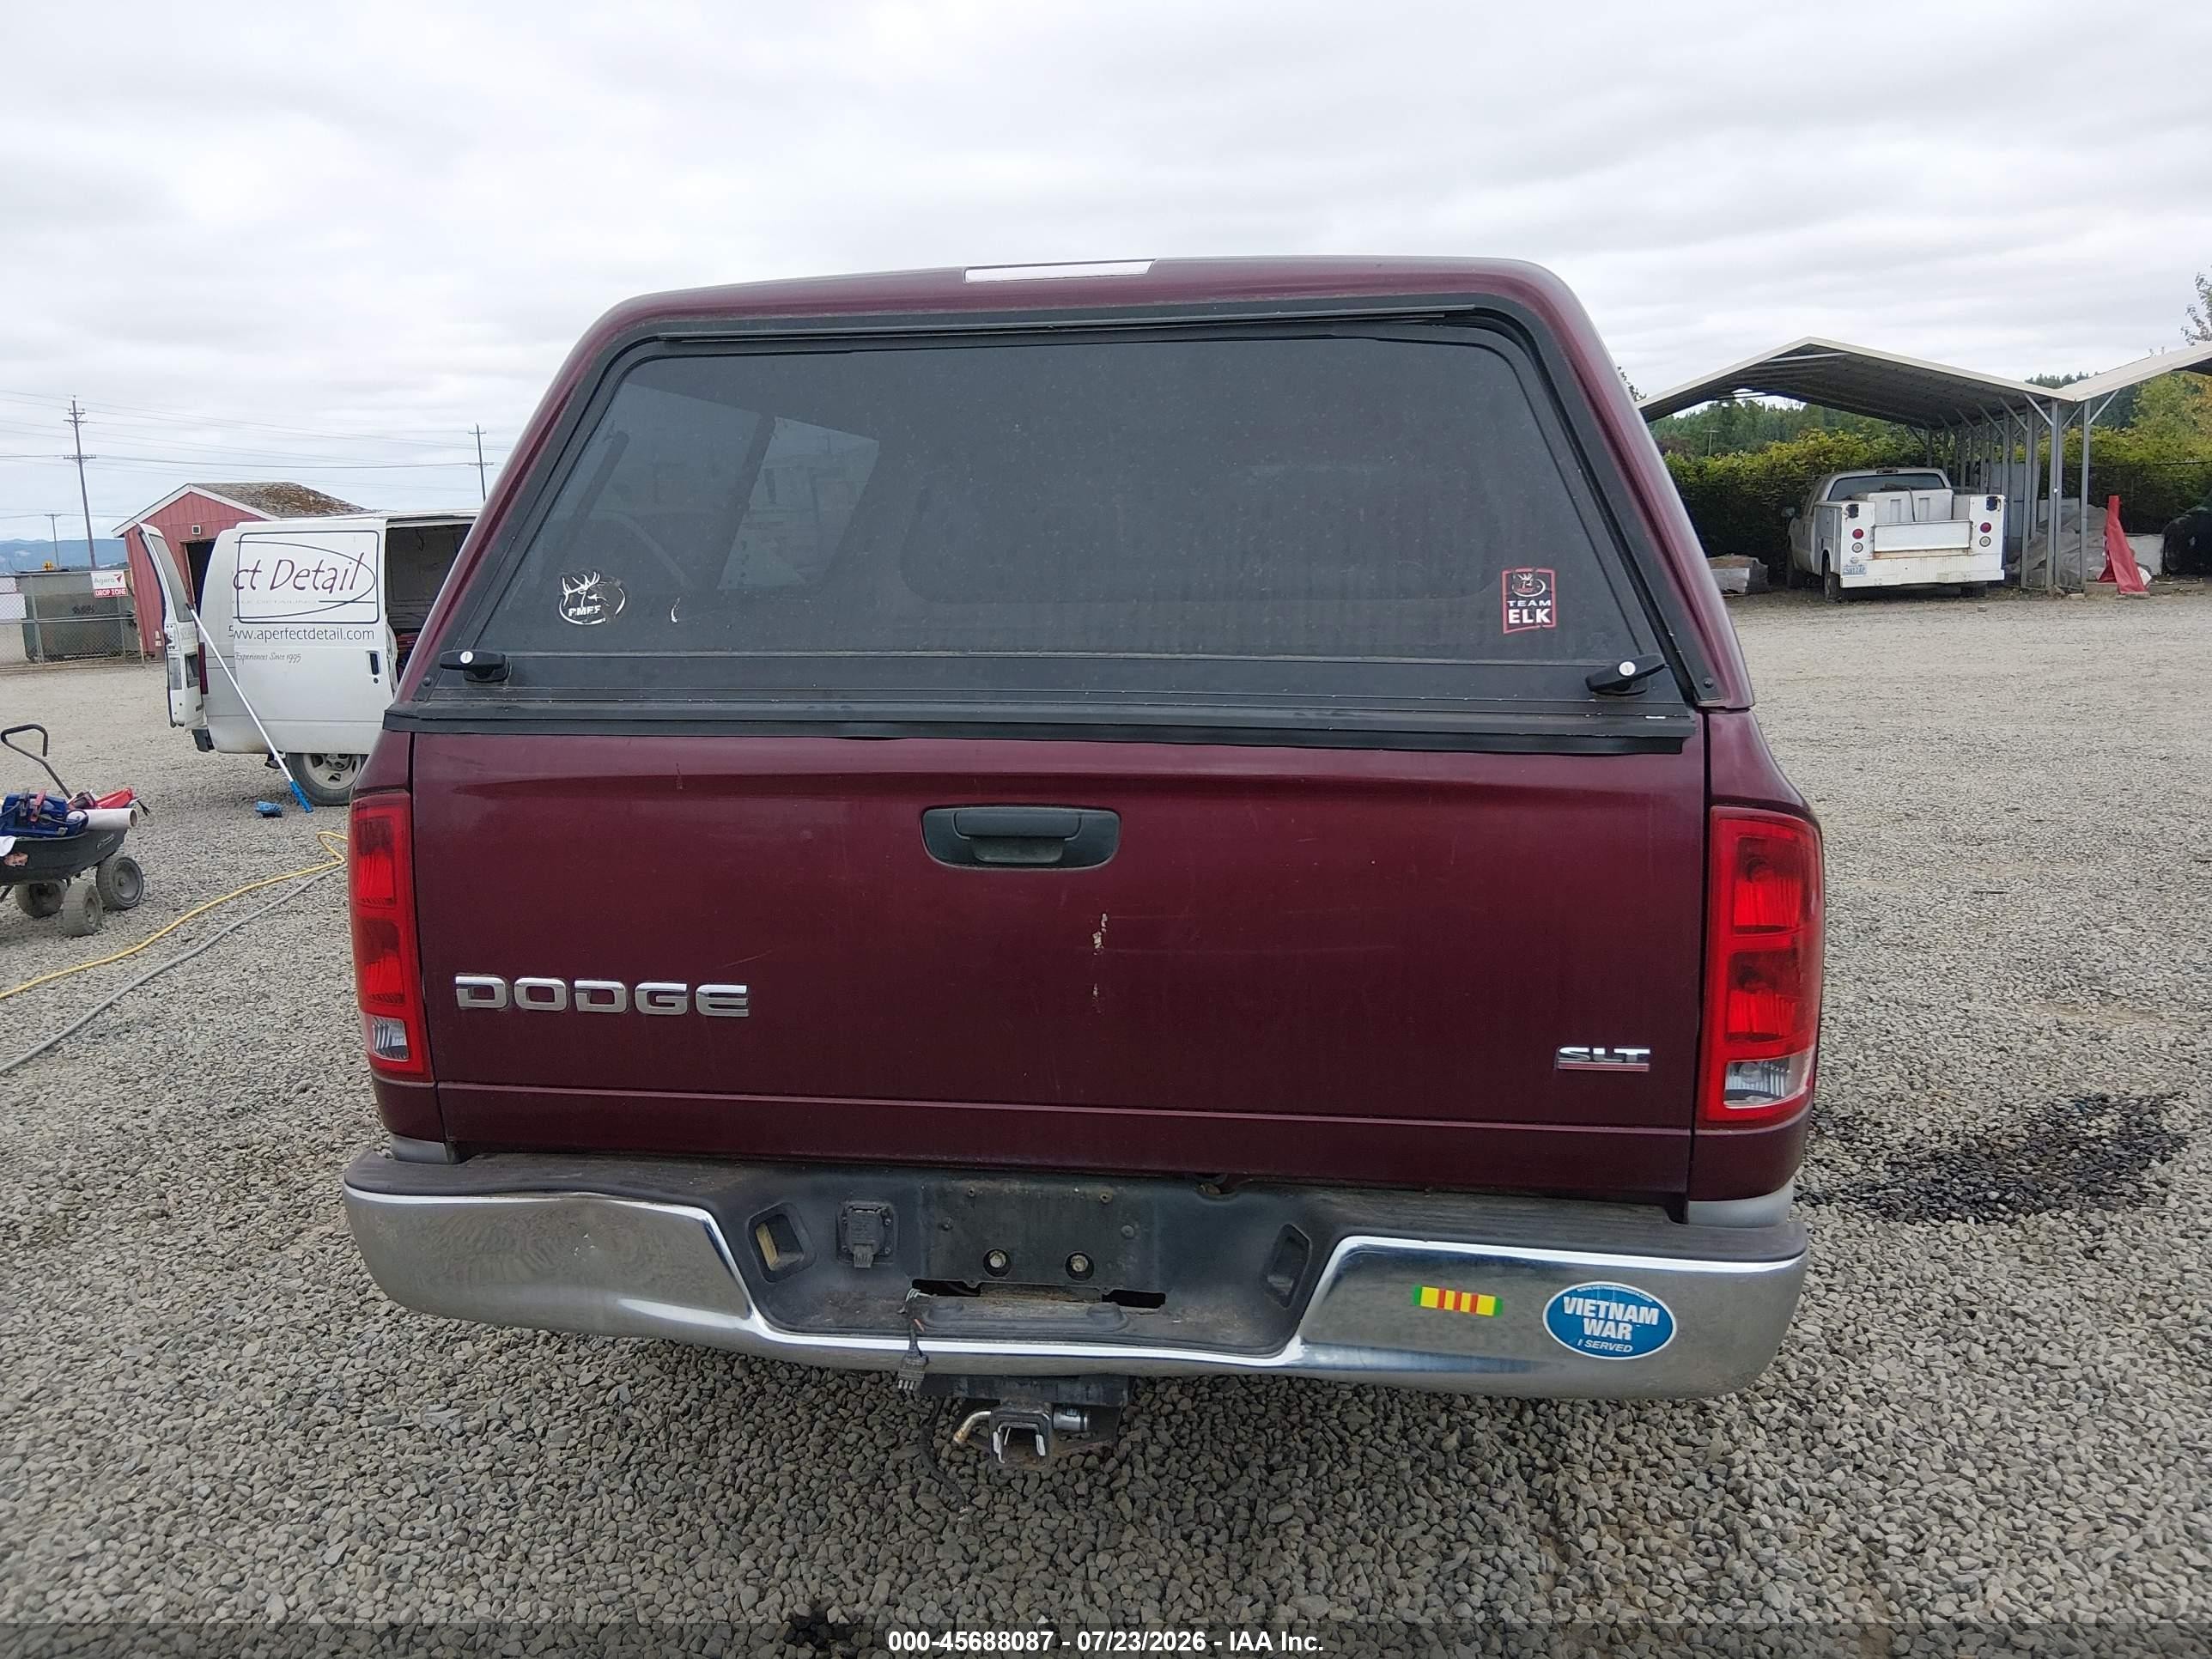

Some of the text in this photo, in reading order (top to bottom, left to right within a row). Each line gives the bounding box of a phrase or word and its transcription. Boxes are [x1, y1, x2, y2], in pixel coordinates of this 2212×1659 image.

[233, 552, 364, 594] ct Detail
[1508, 608, 1552, 623] ELK
[287, 653, 301, 663] 1995
[455, 975, 750, 1018] DODGE
[1557, 1047, 1651, 1062] SLT
[1563, 1296, 1660, 1326] VIETNAM
[1583, 1317, 1632, 1341] WAR
[1577, 1338, 1633, 1353] I SERVED
